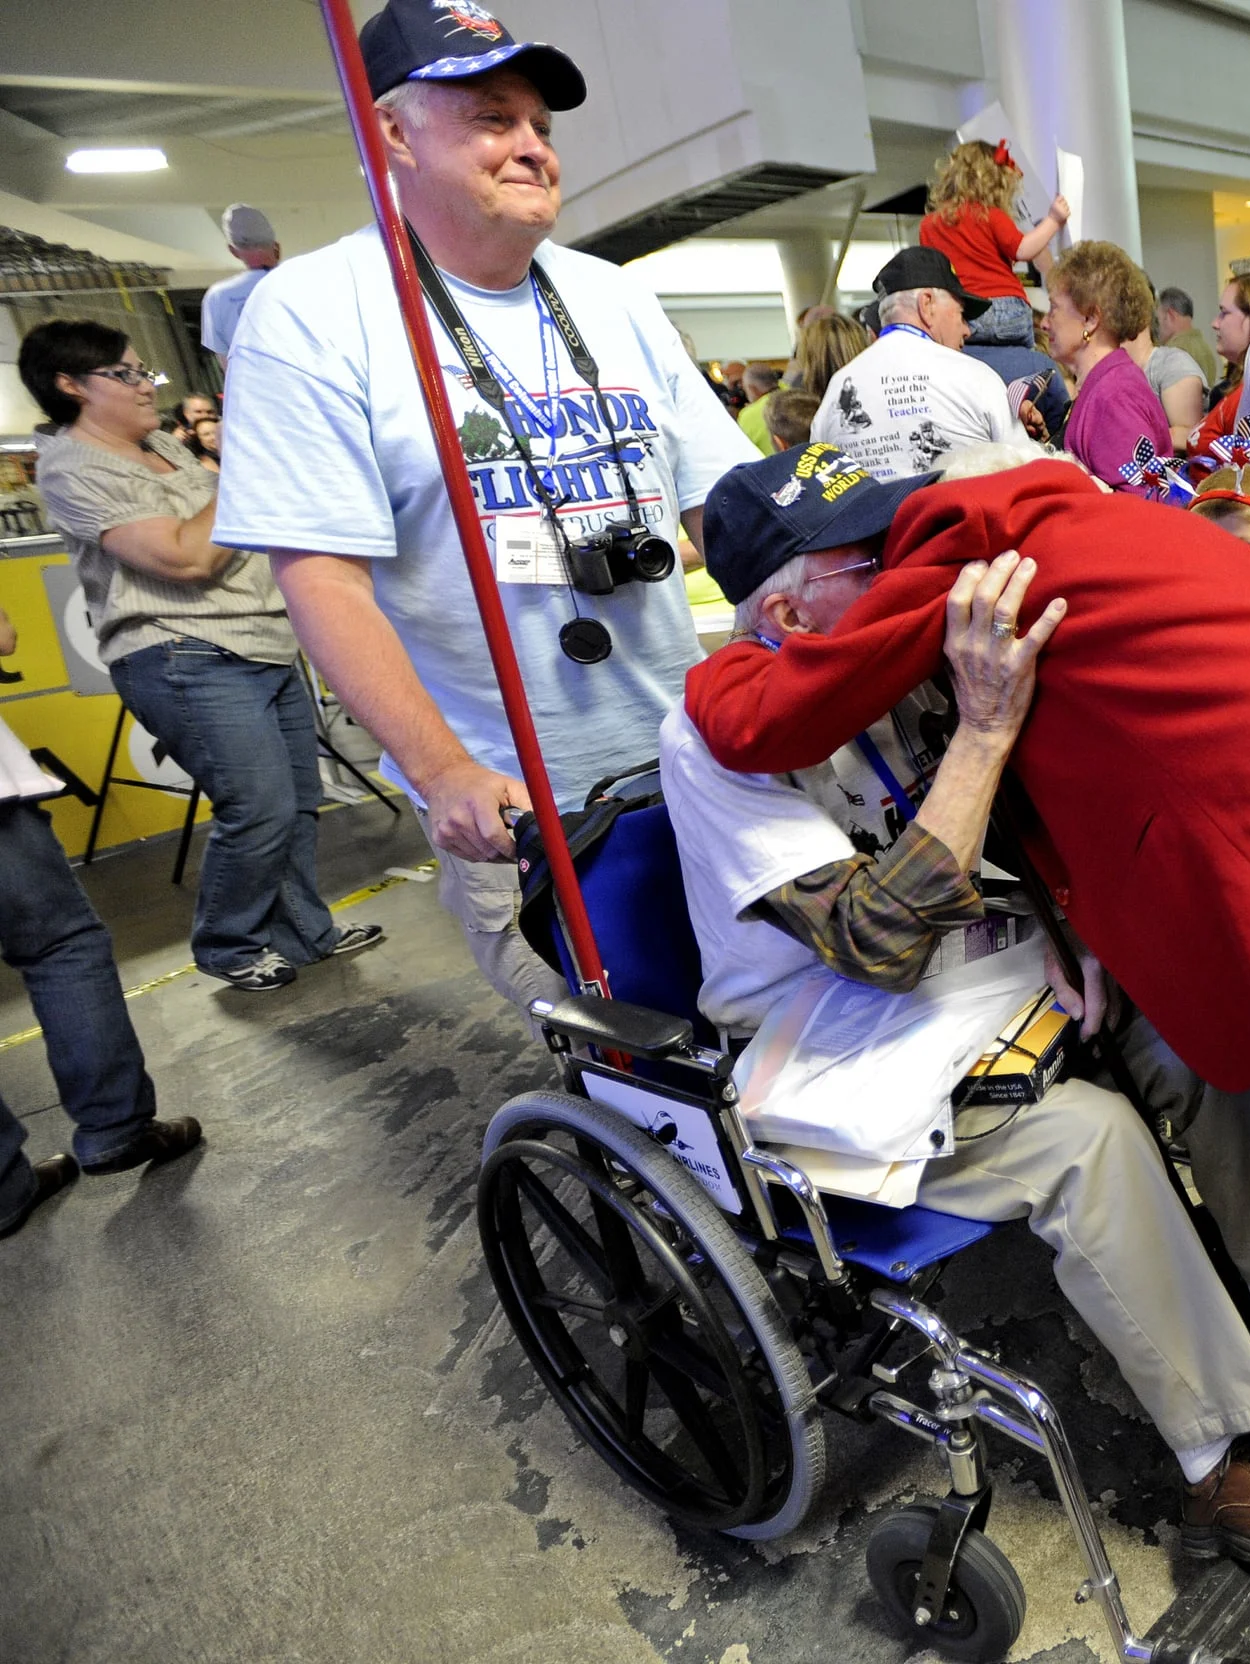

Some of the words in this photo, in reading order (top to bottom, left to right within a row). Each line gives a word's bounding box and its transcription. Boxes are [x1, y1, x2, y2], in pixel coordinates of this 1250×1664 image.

[544, 289, 579, 346] COOLPIX
[455, 327, 483, 368] Nikon
[881, 376, 889, 385] If
[891, 375, 909, 384] you
[884, 385, 906, 396] read
[909, 383, 927, 392] this
[887, 394, 917, 406] thank
[888, 405, 932, 418] Teacher.
[880, 432, 900, 442] read
[865, 443, 903, 457] English,
[795, 453, 818, 479] USS
[859, 457, 882, 468] hank
[821, 472, 861, 503] WORLD
[1008, 1083, 1024, 1091] USA
[915, 1413, 941, 1431] Tracer
